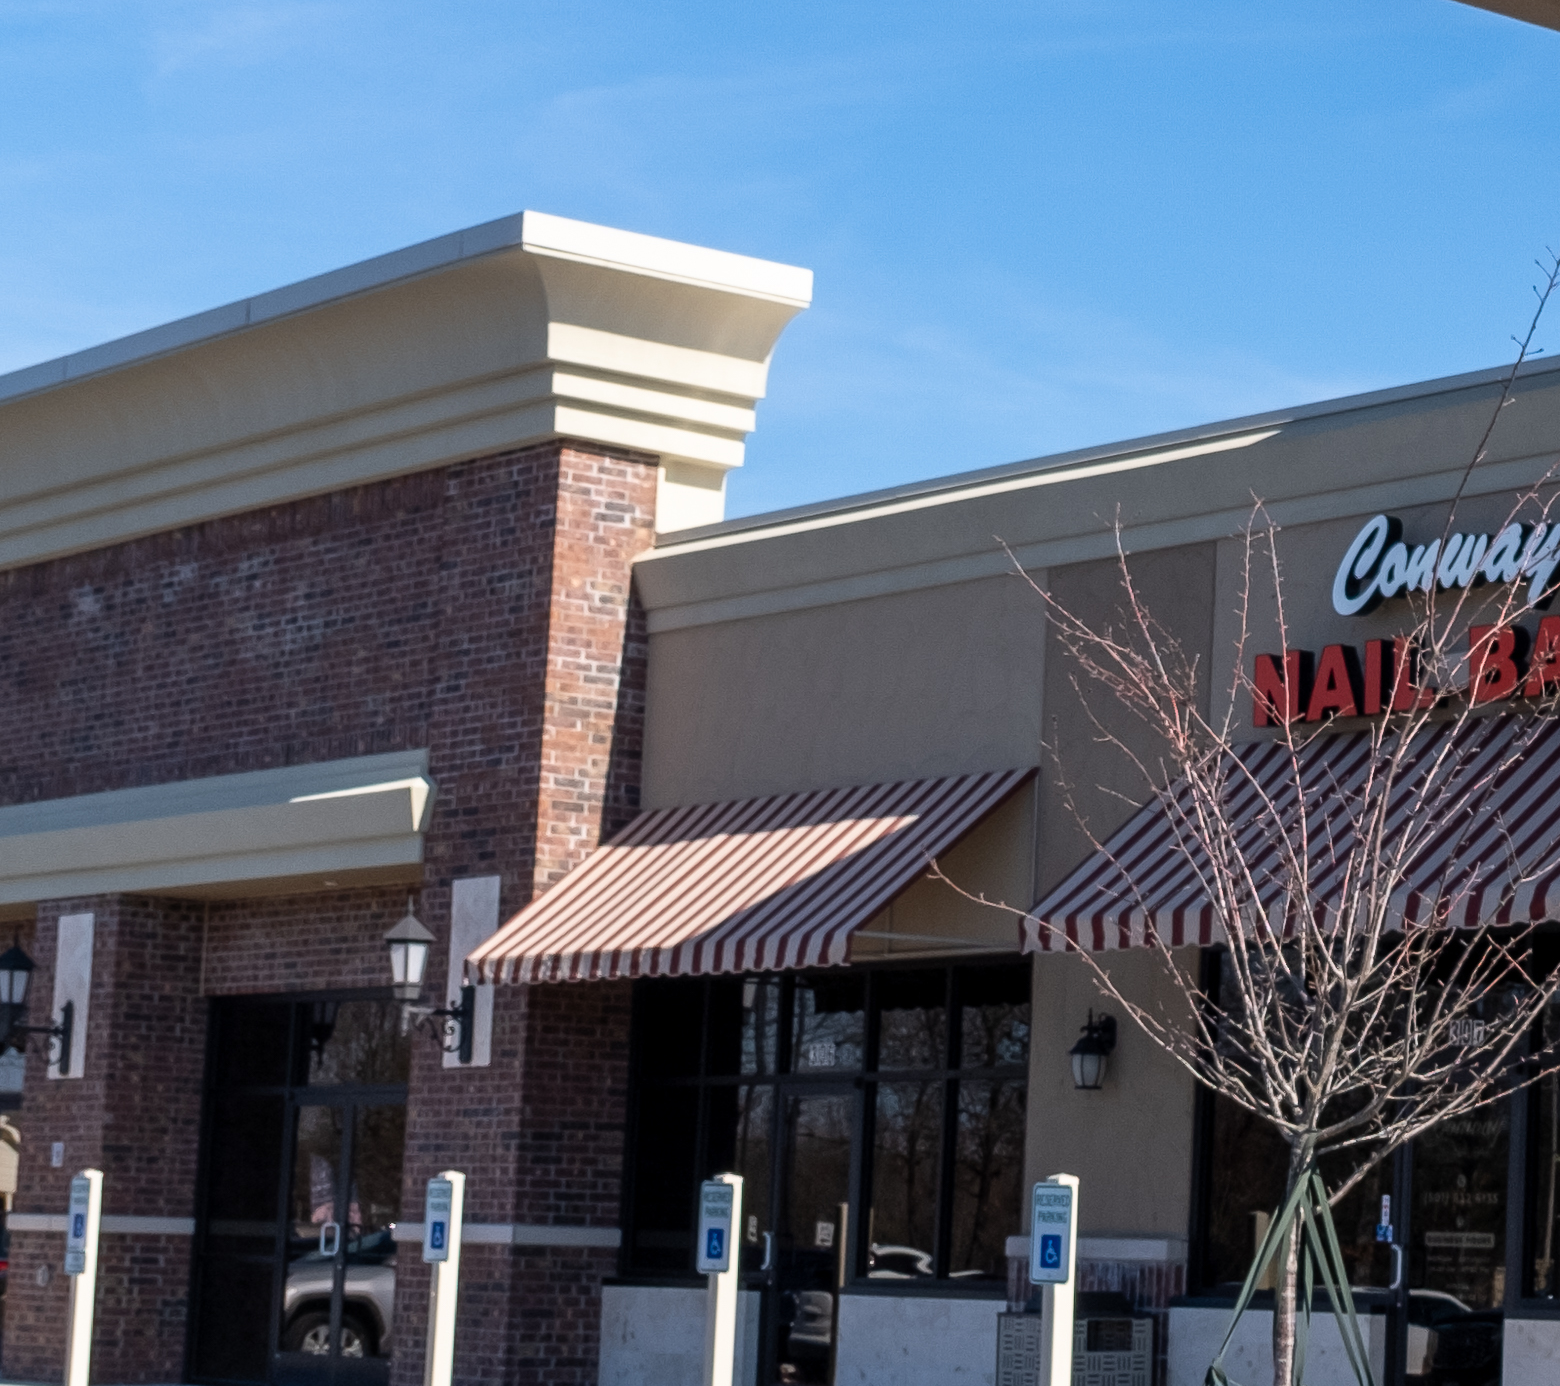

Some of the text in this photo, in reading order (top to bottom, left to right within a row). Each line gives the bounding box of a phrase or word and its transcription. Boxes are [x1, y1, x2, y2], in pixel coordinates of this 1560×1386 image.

[1253, 637, 1434, 727] NAIL
[1036, 1193, 1070, 1206] RESERVED
[1037, 1210, 1067, 1223] PARKING
